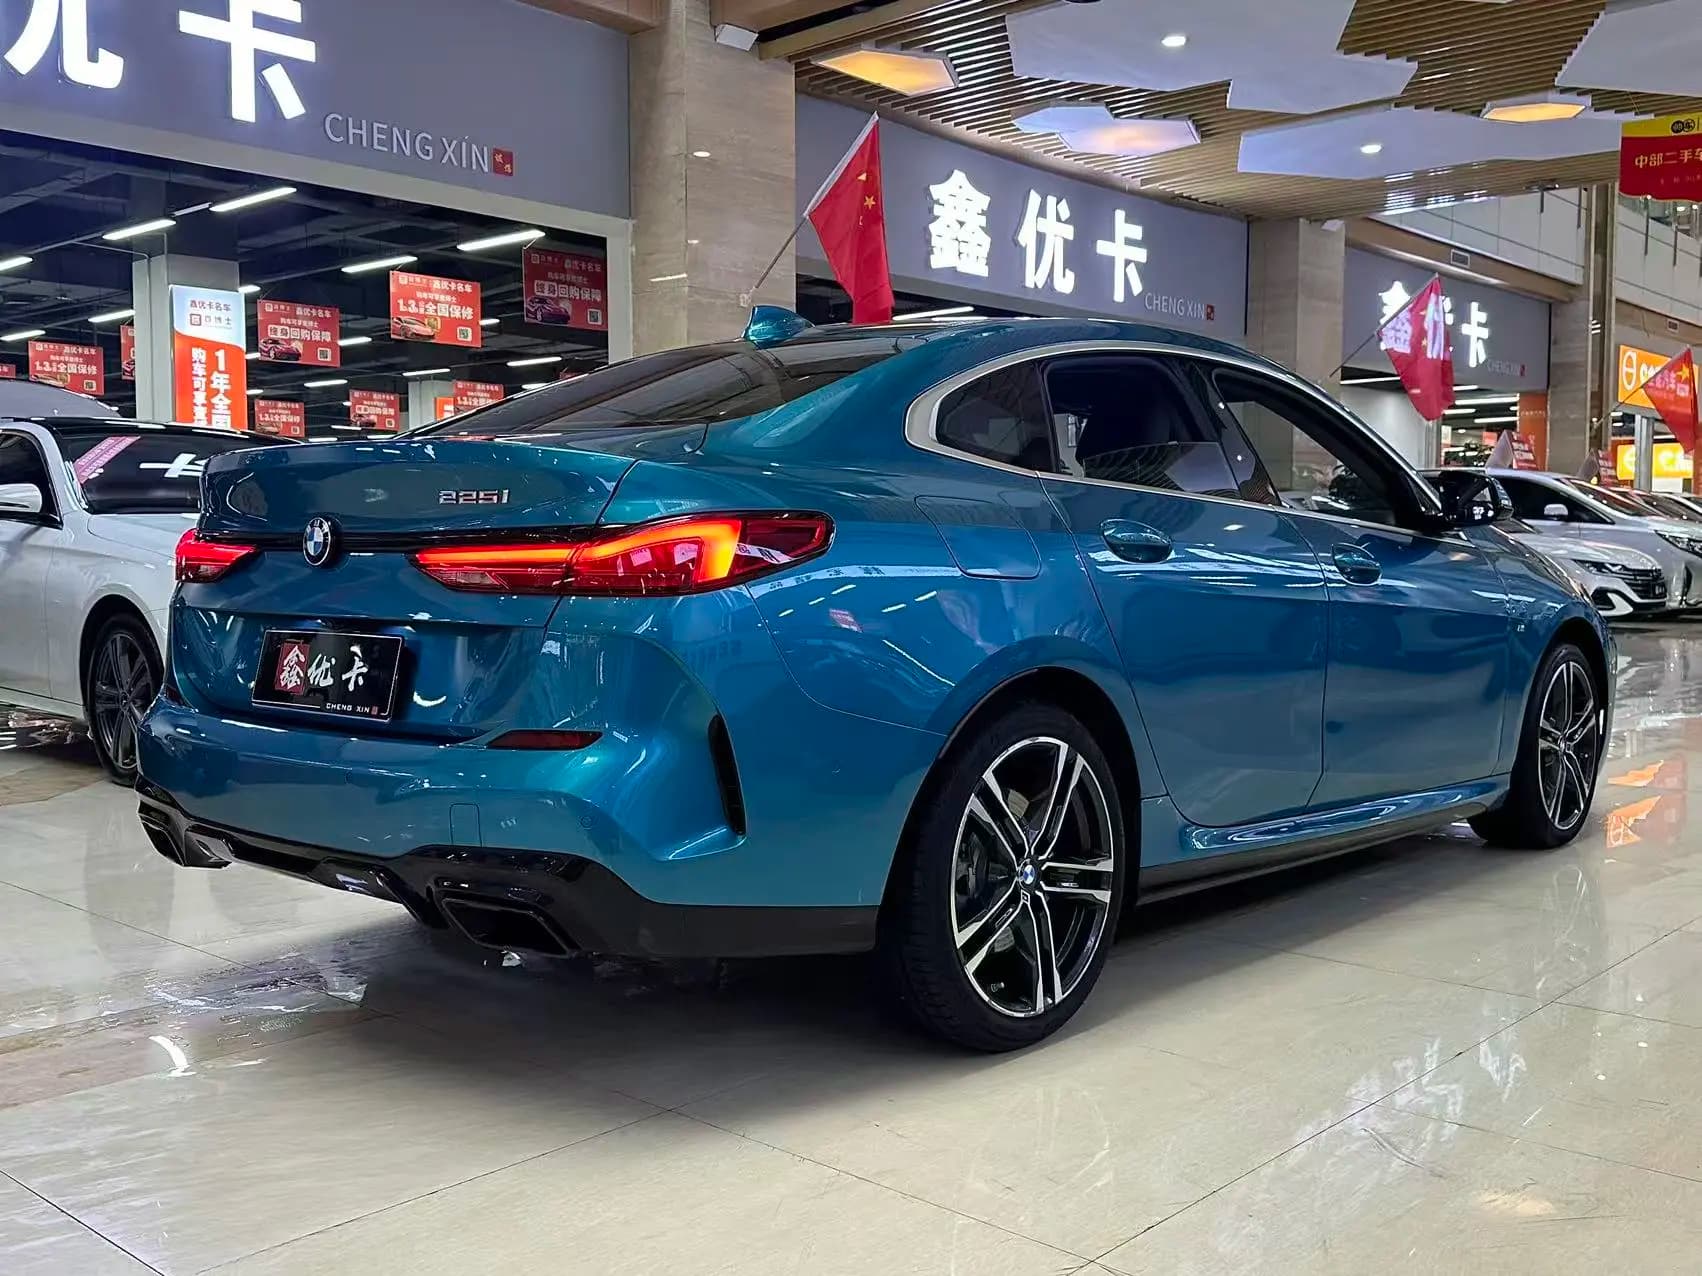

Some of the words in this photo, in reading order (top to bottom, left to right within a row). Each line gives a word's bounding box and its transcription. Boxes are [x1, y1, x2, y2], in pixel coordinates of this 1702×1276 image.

[324, 113, 434, 161] CHENG
[928, 169, 1147, 302] 鑫优卡
[1145, 292, 1185, 316] CHENG
[326, 702, 352, 711] CHENG
[356, 704, 370, 713] XIN
